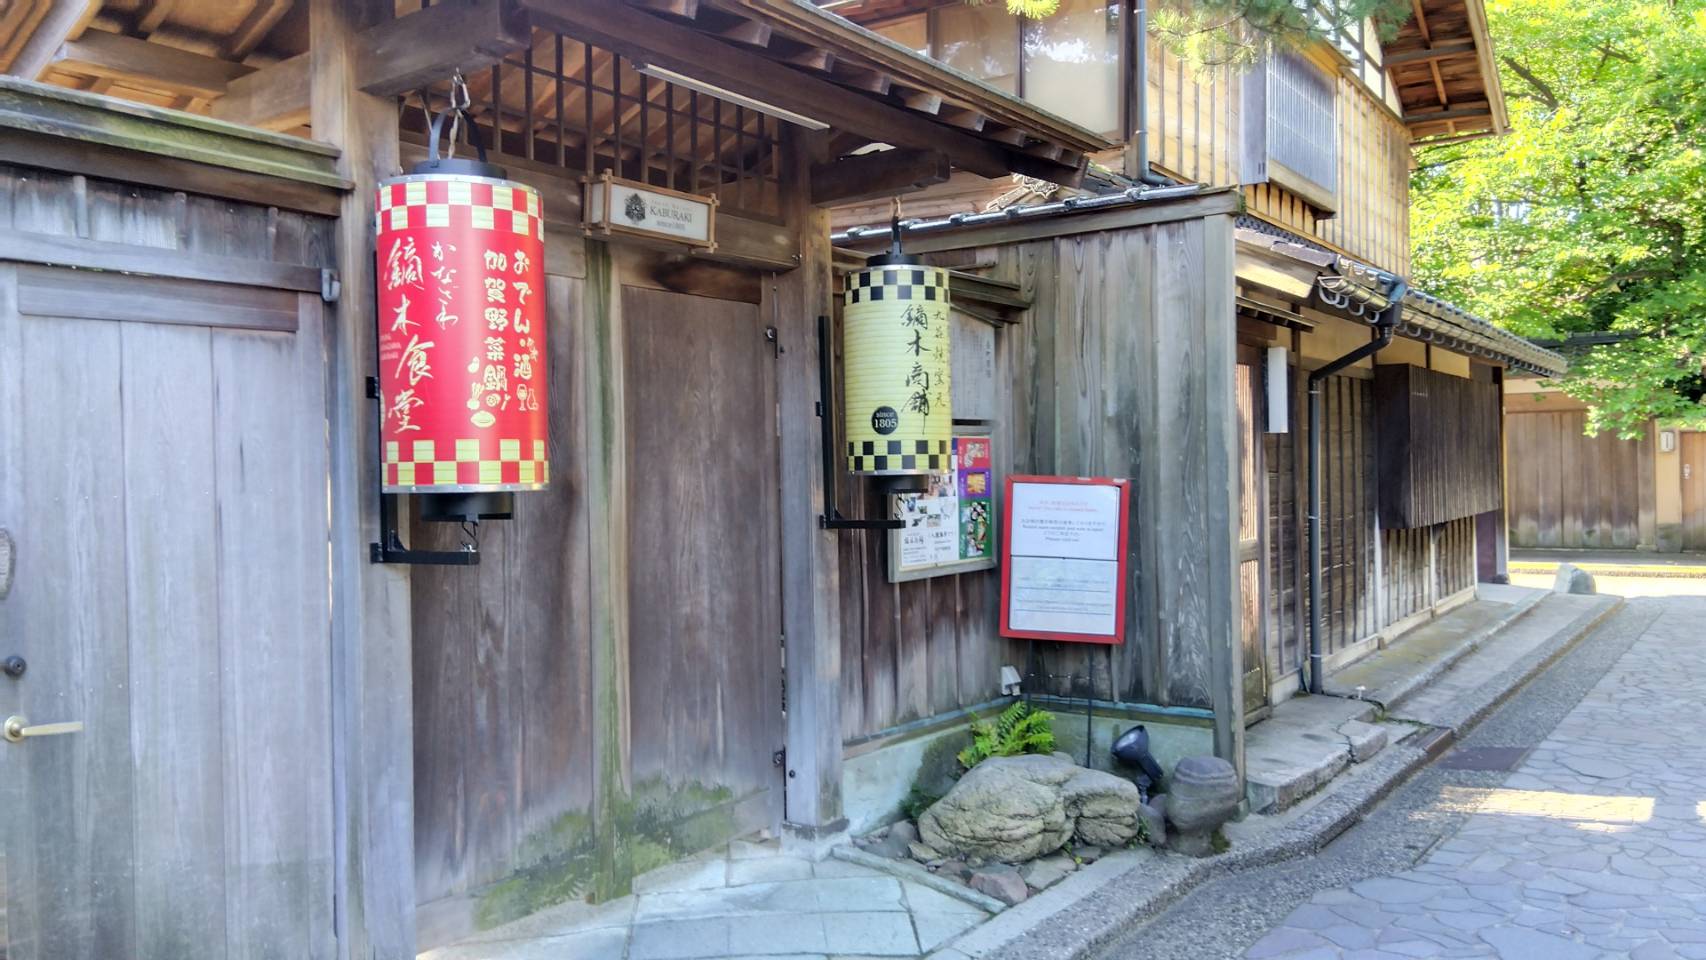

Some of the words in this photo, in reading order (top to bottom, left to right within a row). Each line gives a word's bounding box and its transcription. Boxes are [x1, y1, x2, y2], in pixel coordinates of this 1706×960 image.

[650, 206, 692, 224] KABURAKI
[383, 237, 435, 434] 鏑木食堂
[431, 241, 459, 331] かなざわ
[483, 250, 509, 391] 加賀野菜鍋
[874, 418, 897, 429] 1805
[900, 304, 932, 435] 鏑木商舗
